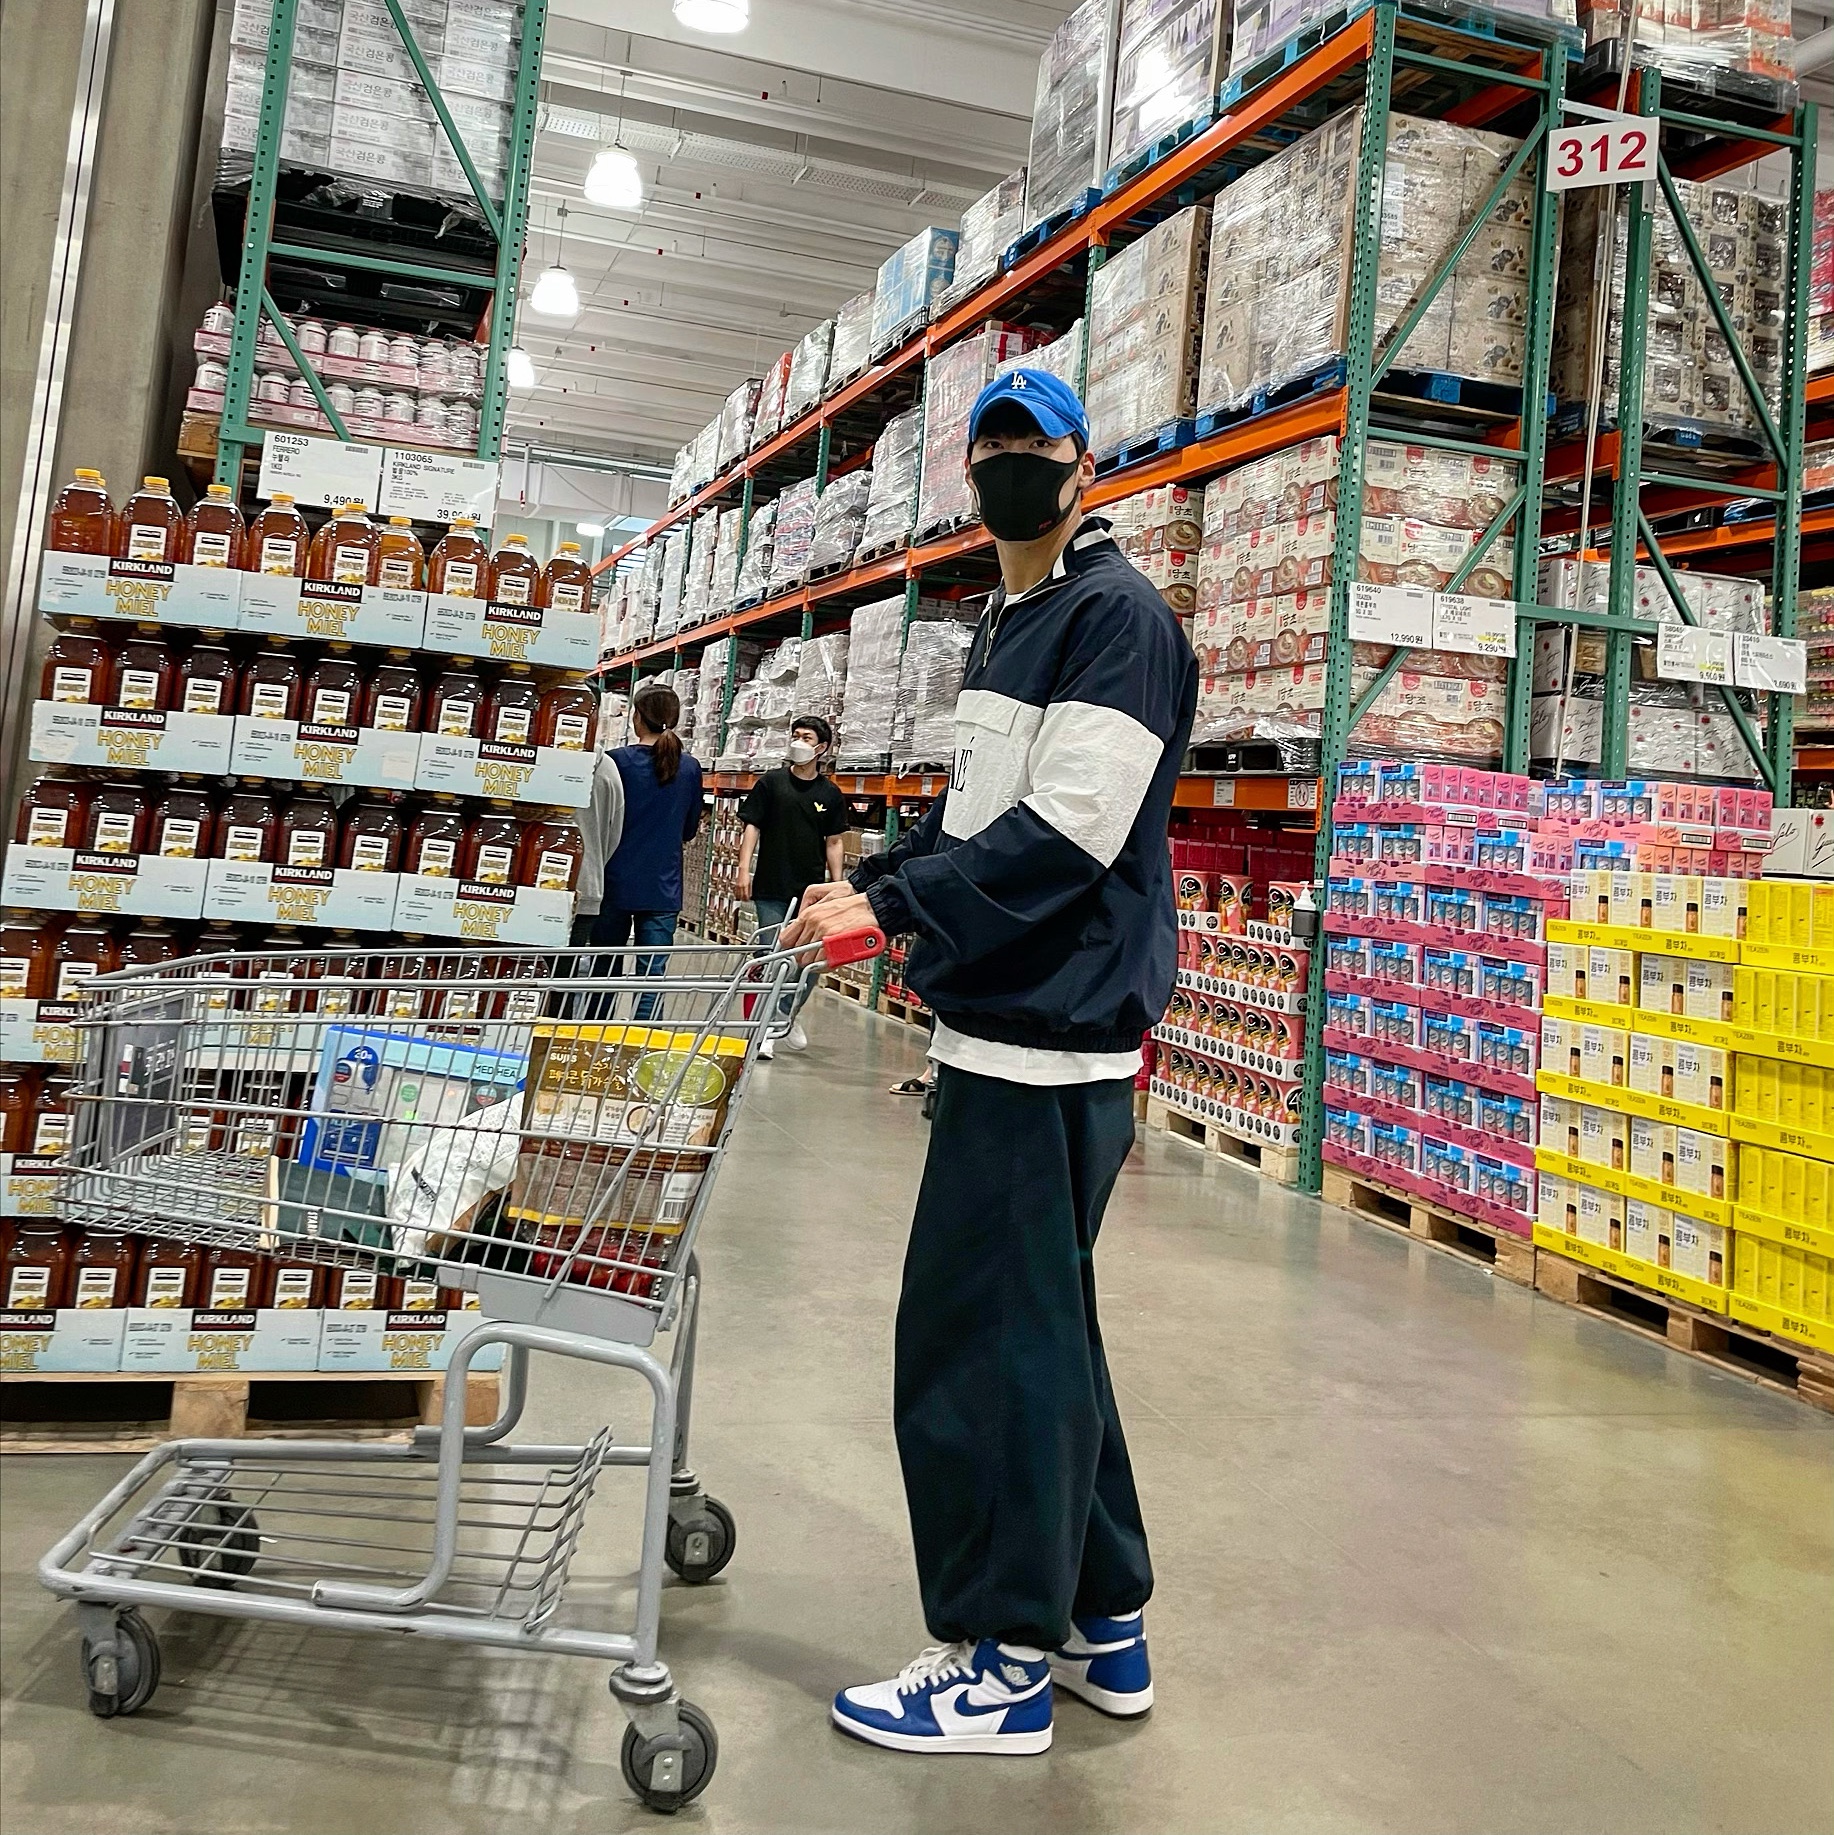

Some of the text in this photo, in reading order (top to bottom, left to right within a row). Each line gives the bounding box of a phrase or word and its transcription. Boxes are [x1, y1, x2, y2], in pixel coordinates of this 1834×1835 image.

[1557, 131, 1646, 177] 312
[1011, 371, 1027, 389] LA
[273, 445, 299, 454] FERRERO
[275, 435, 309, 446] 601253
[395, 452, 432, 463] 1103065
[393, 461, 455, 474] KIRKLAND SIGNATURE
[112, 560, 173, 575] KIRKLAND
[105, 579, 173, 601] HONEY
[303, 582, 361, 596] KIRKLAND
[1356, 585, 1381, 594] 619640
[115, 597, 159, 617] MIEL
[298, 601, 360, 622] HONEY
[488, 606, 542, 621] KIRKLAND
[307, 618, 347, 637] MIEL
[481, 624, 541, 645] HONEY
[490, 641, 527, 659] MIEL
[103, 710, 165, 724] KIRKLAND
[97, 729, 164, 750] HONEY
[301, 725, 358, 738] KIRKLAND
[107, 748, 150, 766] MIEL
[293, 743, 357, 764] HONEY
[482, 743, 536, 758] KIRKLAND
[302, 761, 342, 779] MIEL
[475, 762, 534, 782] HONEY
[482, 779, 521, 797] MIEL
[76, 855, 137, 868] KIRKLAND
[275, 867, 333, 880] KIRKLAND
[68, 874, 137, 895] HONEY
[460, 884, 515, 898] KIRKLAND
[78, 893, 121, 911] MIEL
[268, 885, 332, 906] HONEY
[276, 904, 317, 922] MIEL
[452, 902, 514, 923] HONEY
[460, 919, 499, 938] MIEL
[194, 1315, 255, 1325] KIRKLAND
[388, 1315, 445, 1325] KIRKLAND
[0, 1334, 54, 1352] ONEY
[187, 1334, 254, 1352] HONEY
[381, 1333, 443, 1352] HONEY
[196, 1353, 239, 1370] MIEL
[391, 1352, 431, 1368] MIEL
